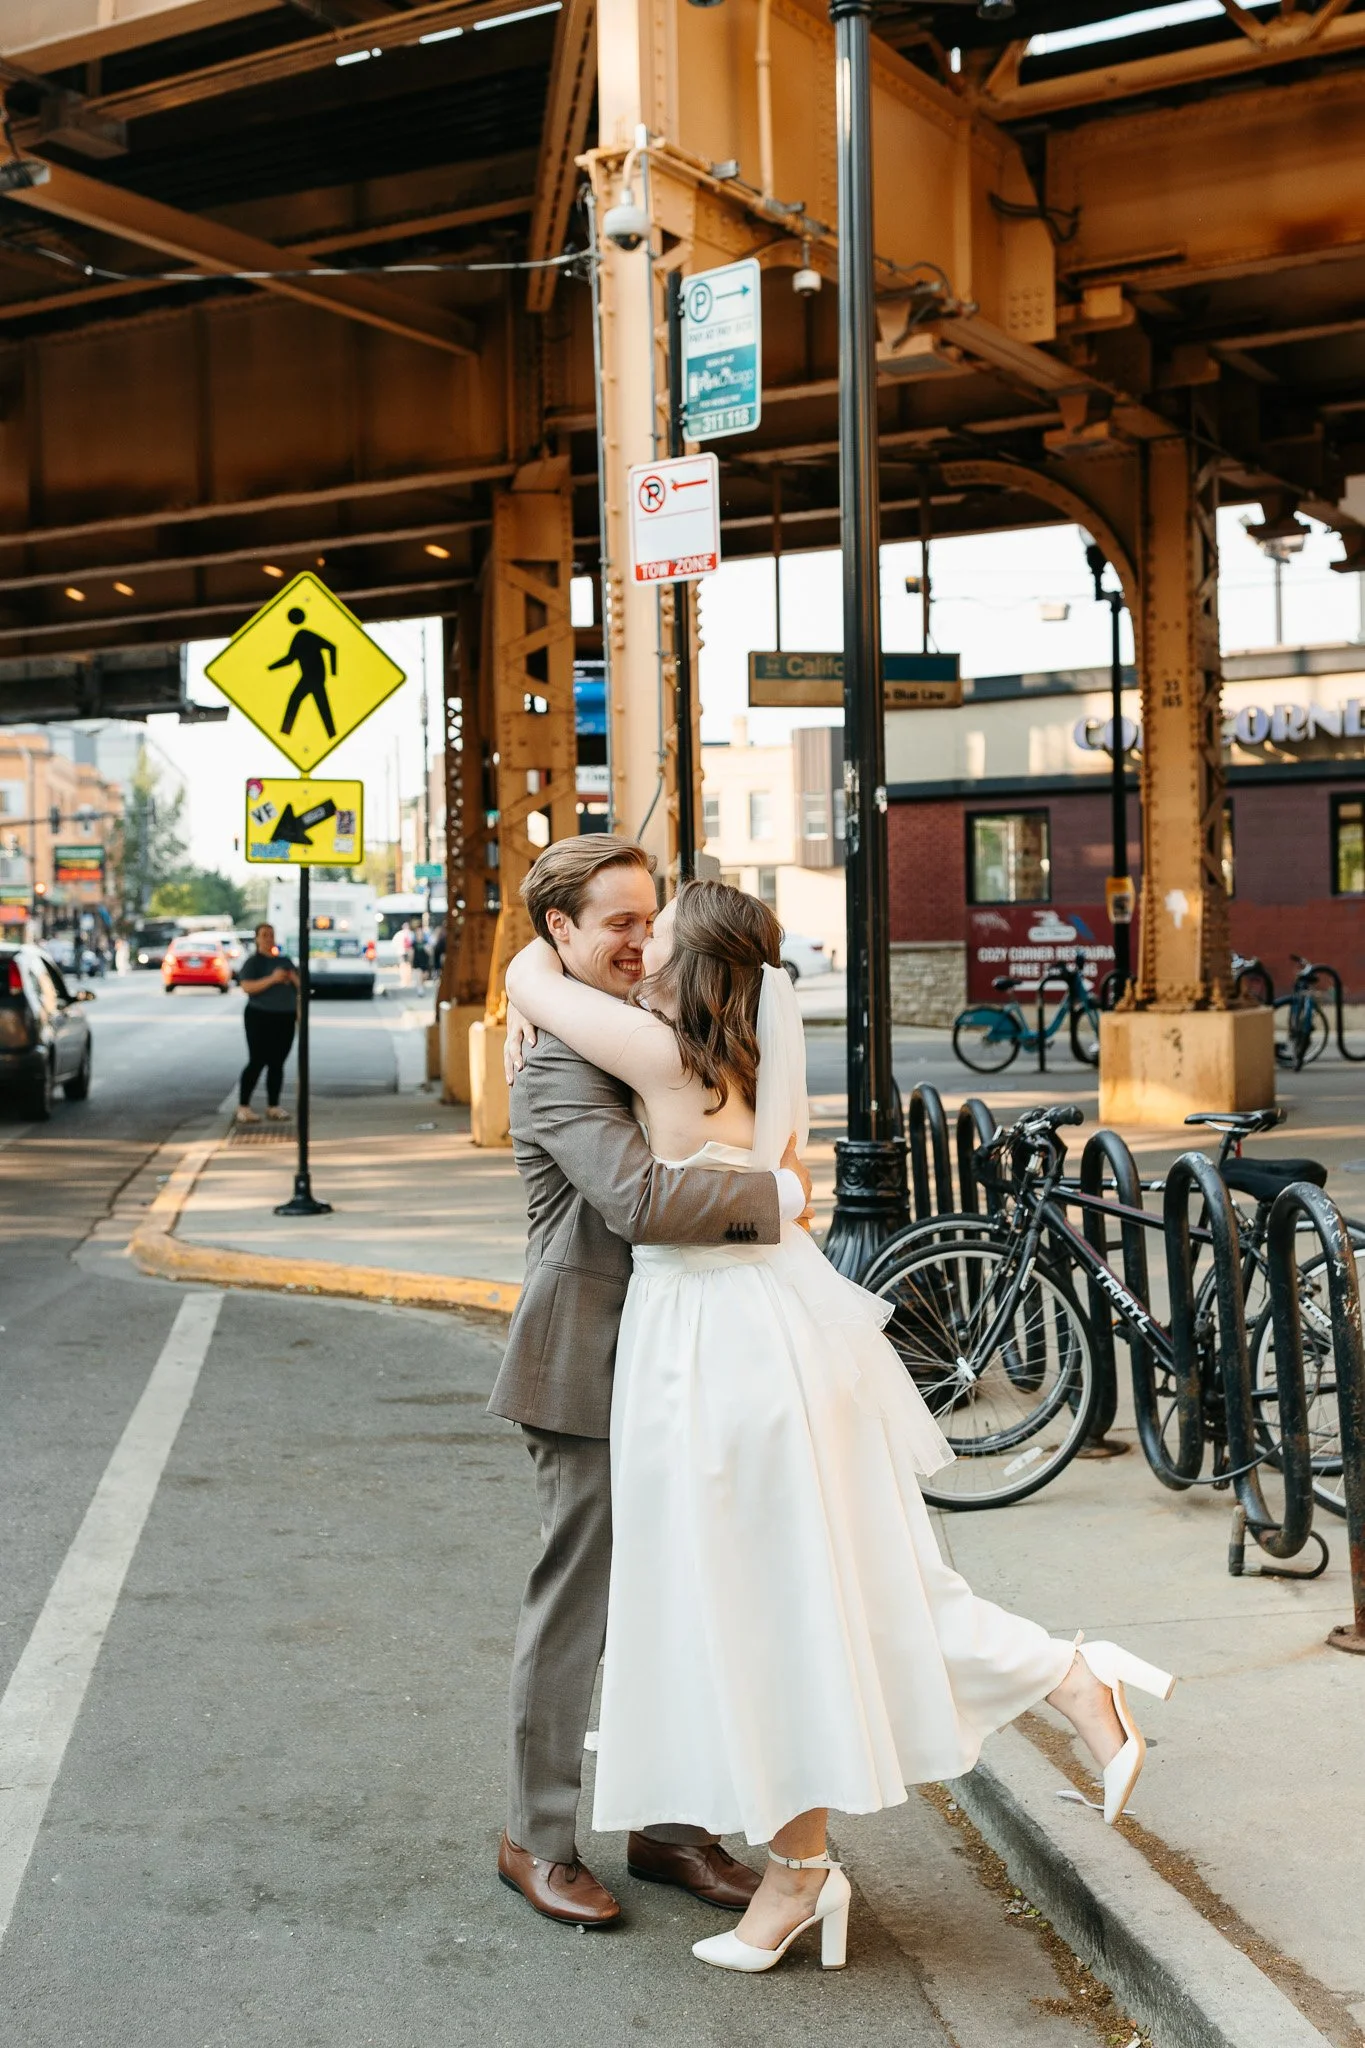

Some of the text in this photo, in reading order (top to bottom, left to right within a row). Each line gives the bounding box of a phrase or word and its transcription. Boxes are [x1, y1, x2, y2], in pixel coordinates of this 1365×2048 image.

[640, 554, 715, 580] TOW ZONE
[786, 656, 845, 678] Califo
[1095, 1265, 1150, 1333] TRAYL
[1302, 1296, 1333, 1328] TRA
